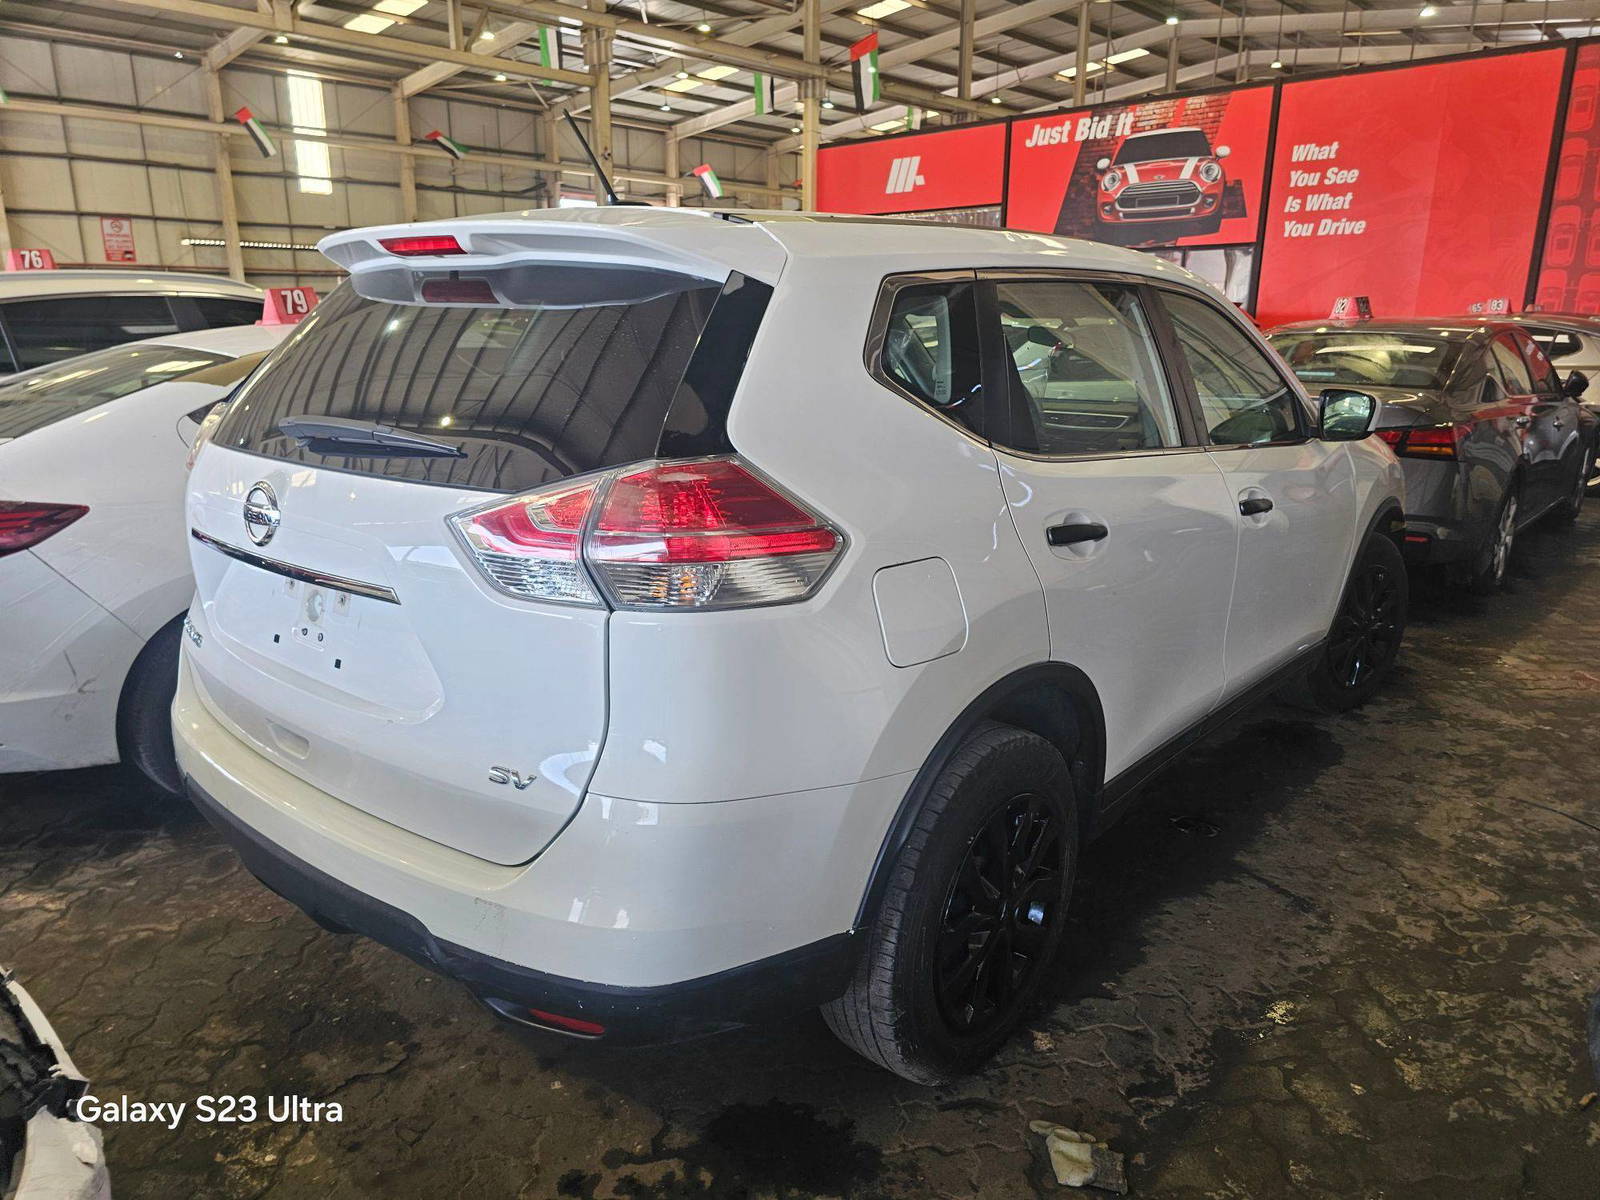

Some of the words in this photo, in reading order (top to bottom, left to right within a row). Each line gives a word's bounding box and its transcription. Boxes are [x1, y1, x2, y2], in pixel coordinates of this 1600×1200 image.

[1025, 117, 1072, 148] Just
[1074, 115, 1111, 142] Bid
[1115, 110, 1135, 136] It
[1291, 141, 1340, 162] What
[1289, 170, 1321, 188] You
[1323, 167, 1359, 185] See
[1283, 195, 1302, 213] Is
[1305, 192, 1353, 212] What
[1283, 220, 1314, 238] You
[1317, 217, 1366, 236] Drive
[20, 250, 43, 269] 76
[281, 289, 308, 315] 79
[488, 766, 537, 790] SV
